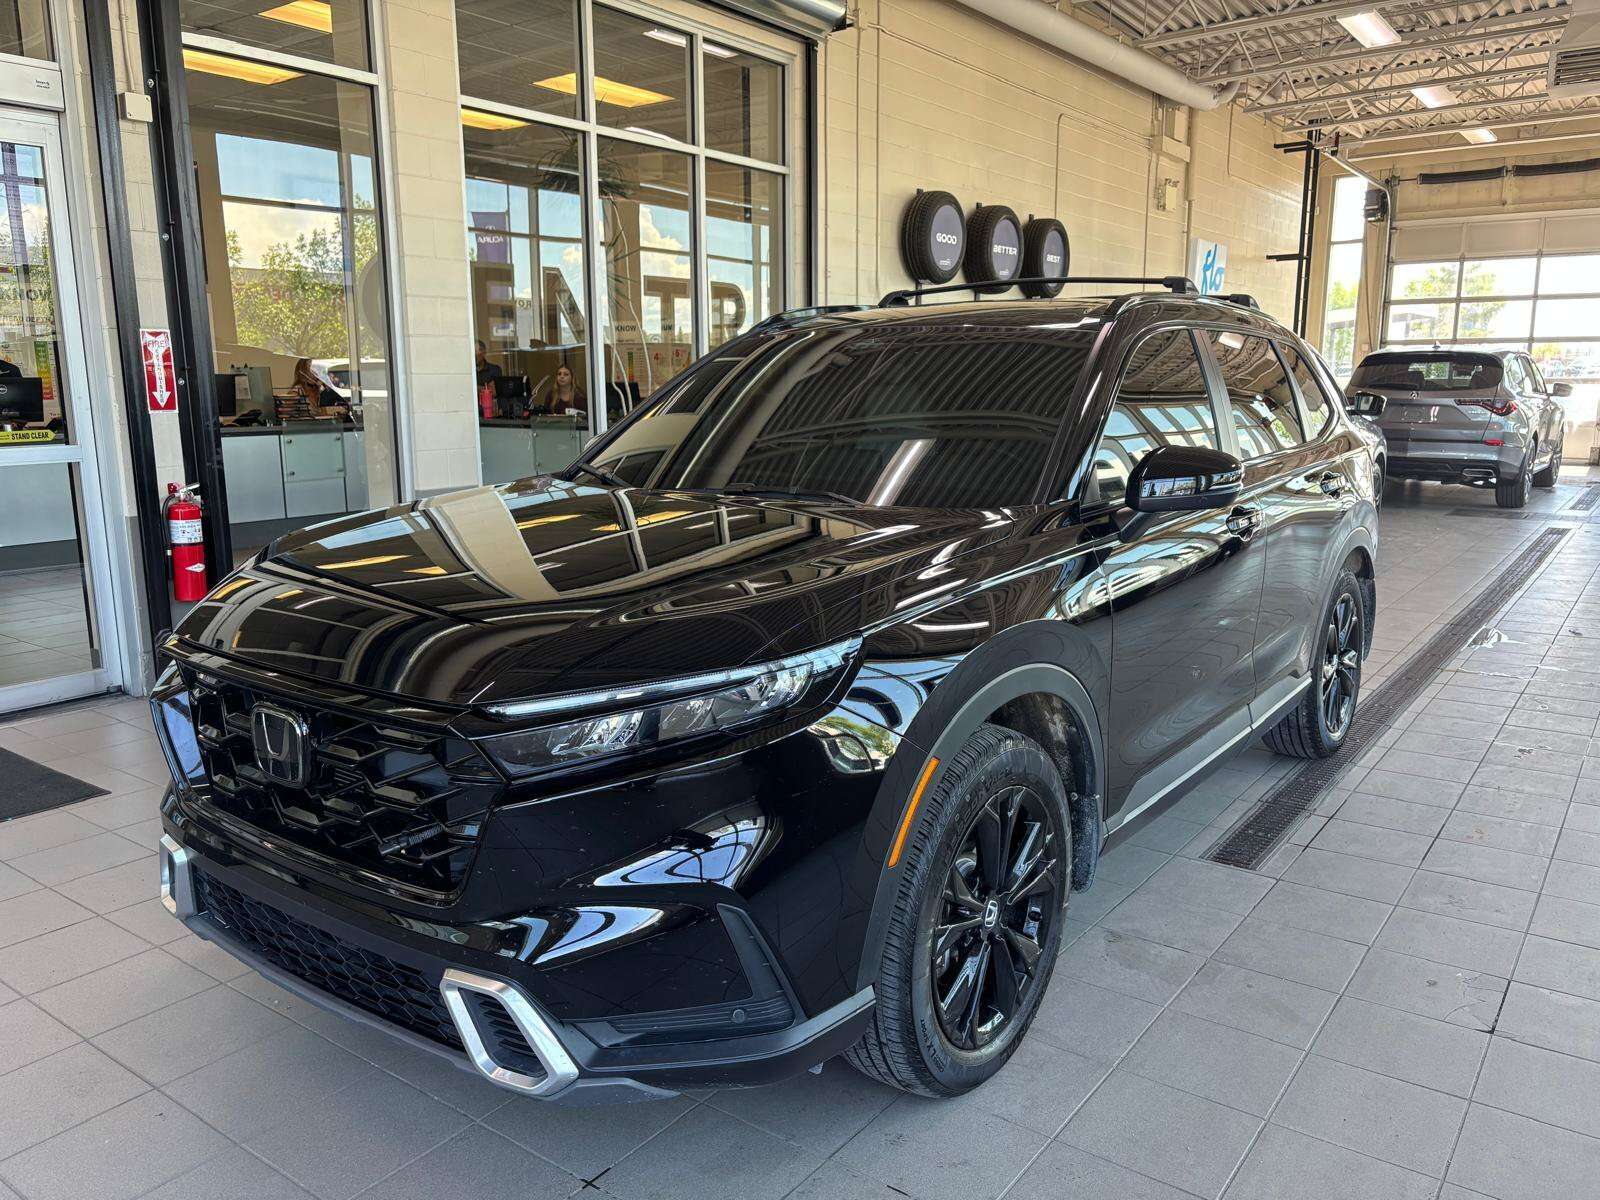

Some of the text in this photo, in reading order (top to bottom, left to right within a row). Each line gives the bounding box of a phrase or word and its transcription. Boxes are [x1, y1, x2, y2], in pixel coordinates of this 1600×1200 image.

[936, 232, 957, 245] GOOD
[993, 245, 1018, 256] BETTER
[1047, 254, 1061, 263] BEST
[616, 324, 637, 332] KNOW
[11, 431, 50, 441] STAND CLEAR
